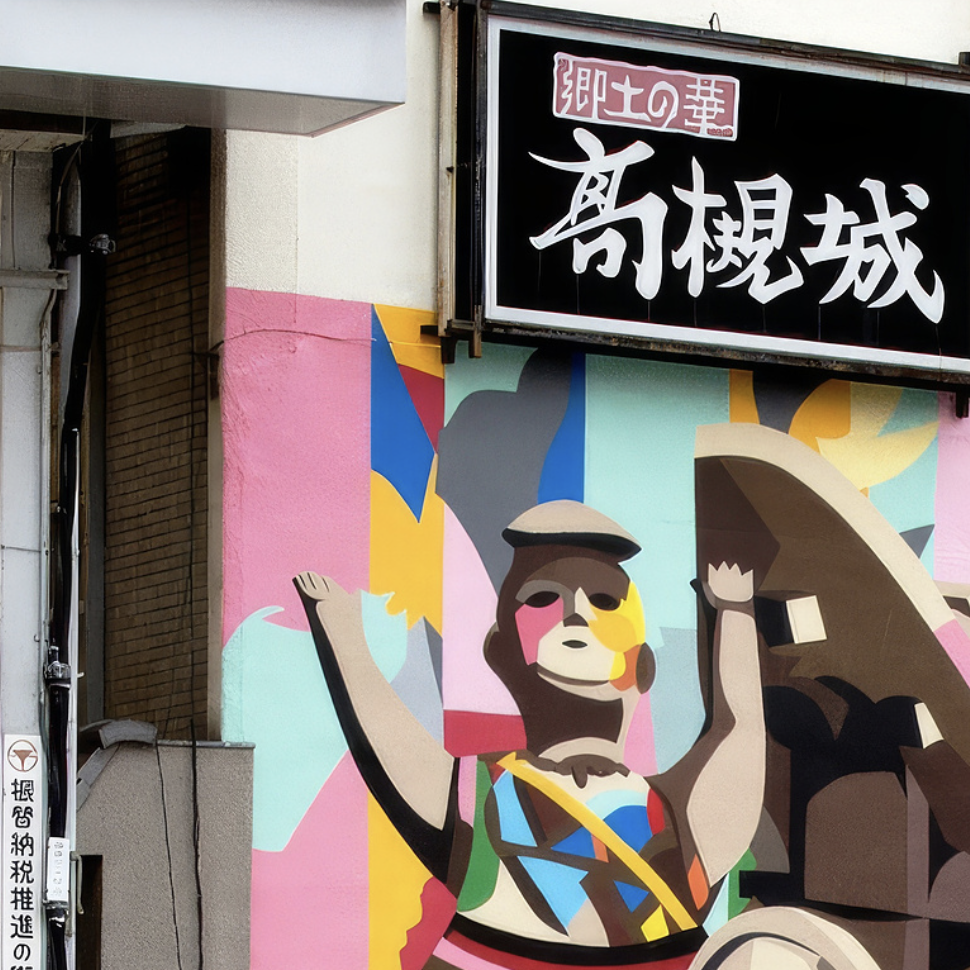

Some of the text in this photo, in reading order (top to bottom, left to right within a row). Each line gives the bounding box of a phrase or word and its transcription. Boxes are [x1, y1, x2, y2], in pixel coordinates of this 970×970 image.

[556, 58, 735, 138] 郷土の華
[528, 127, 946, 324] 高槻城
